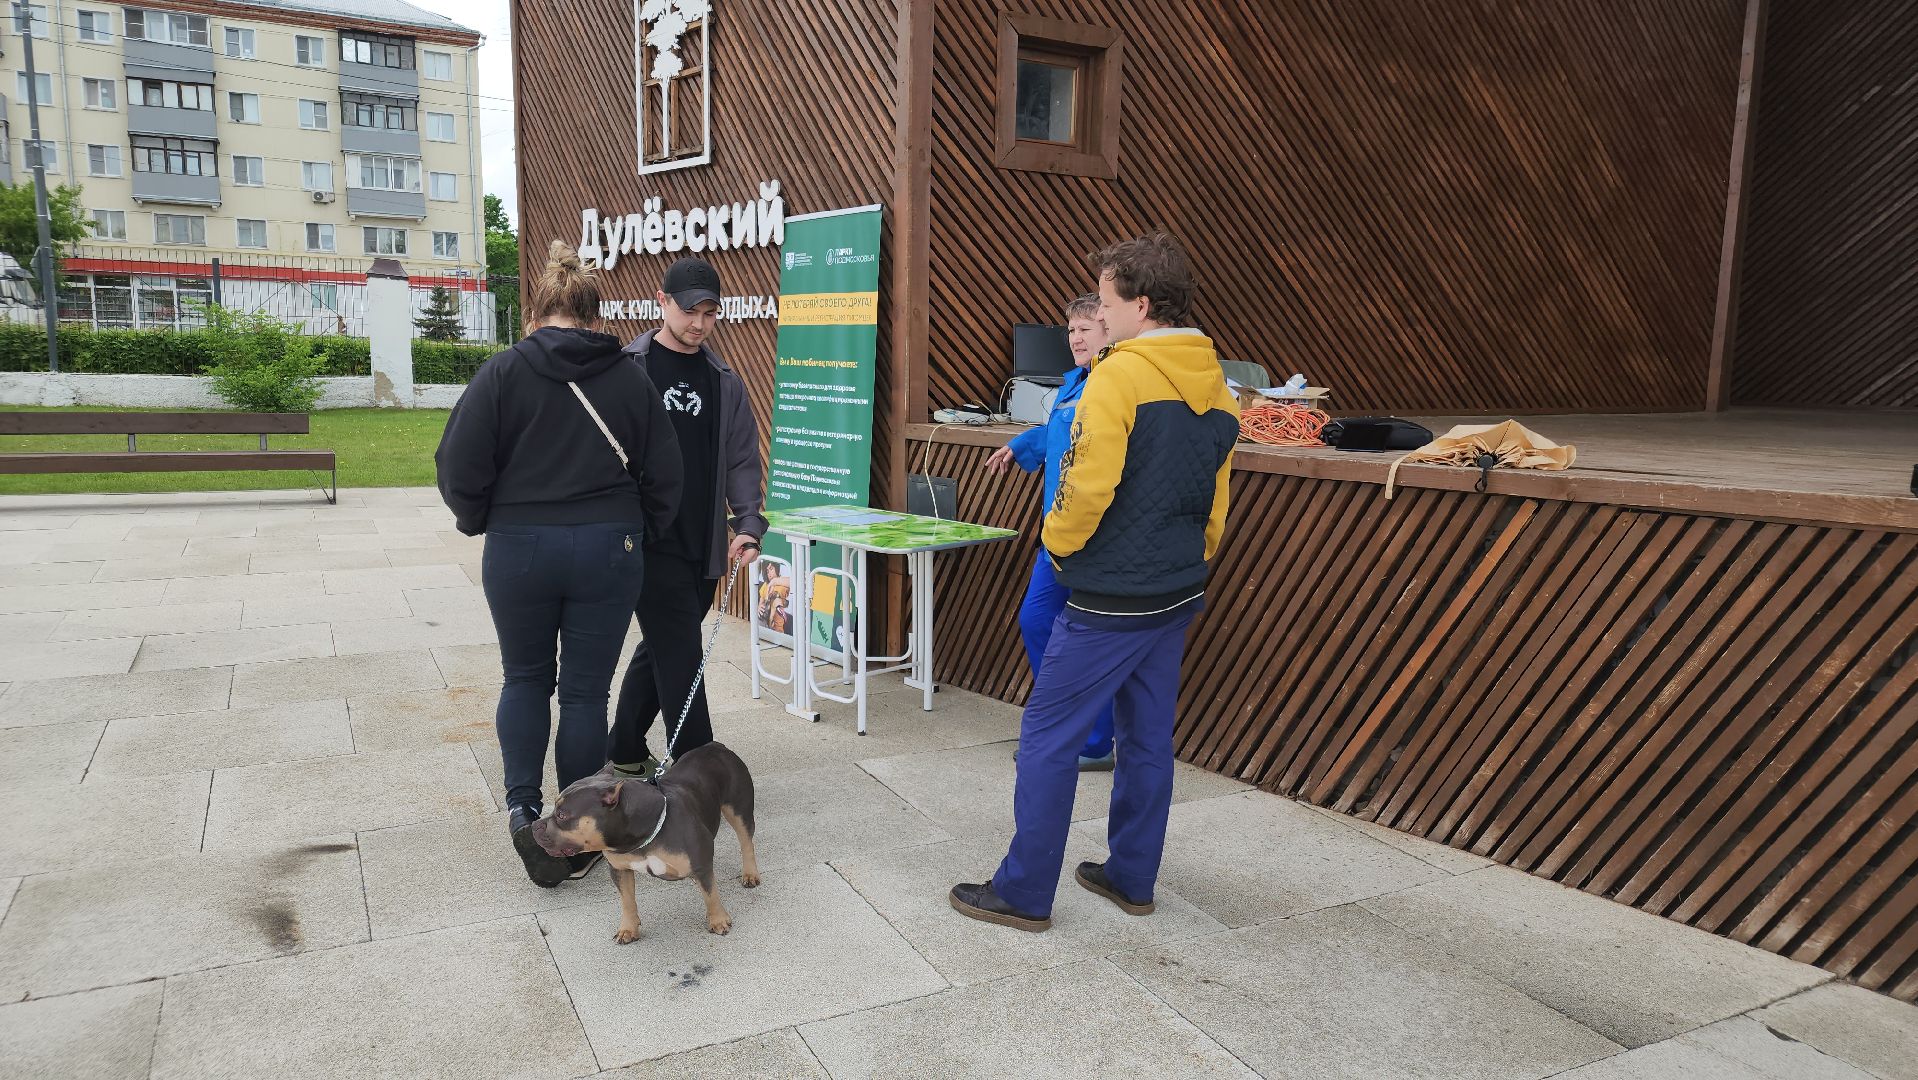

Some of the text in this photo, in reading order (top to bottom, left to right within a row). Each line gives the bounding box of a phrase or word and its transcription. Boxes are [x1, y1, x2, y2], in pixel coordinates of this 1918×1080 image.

[578, 179, 785, 270] Дулёвский
[834, 255, 875, 264] ПОДМОСКОВЬЯ
[628, 299, 665, 320] КУЛЬ
[819, 298, 847, 308] СВОЕГО
[848, 297, 872, 310] ДРУГА!
